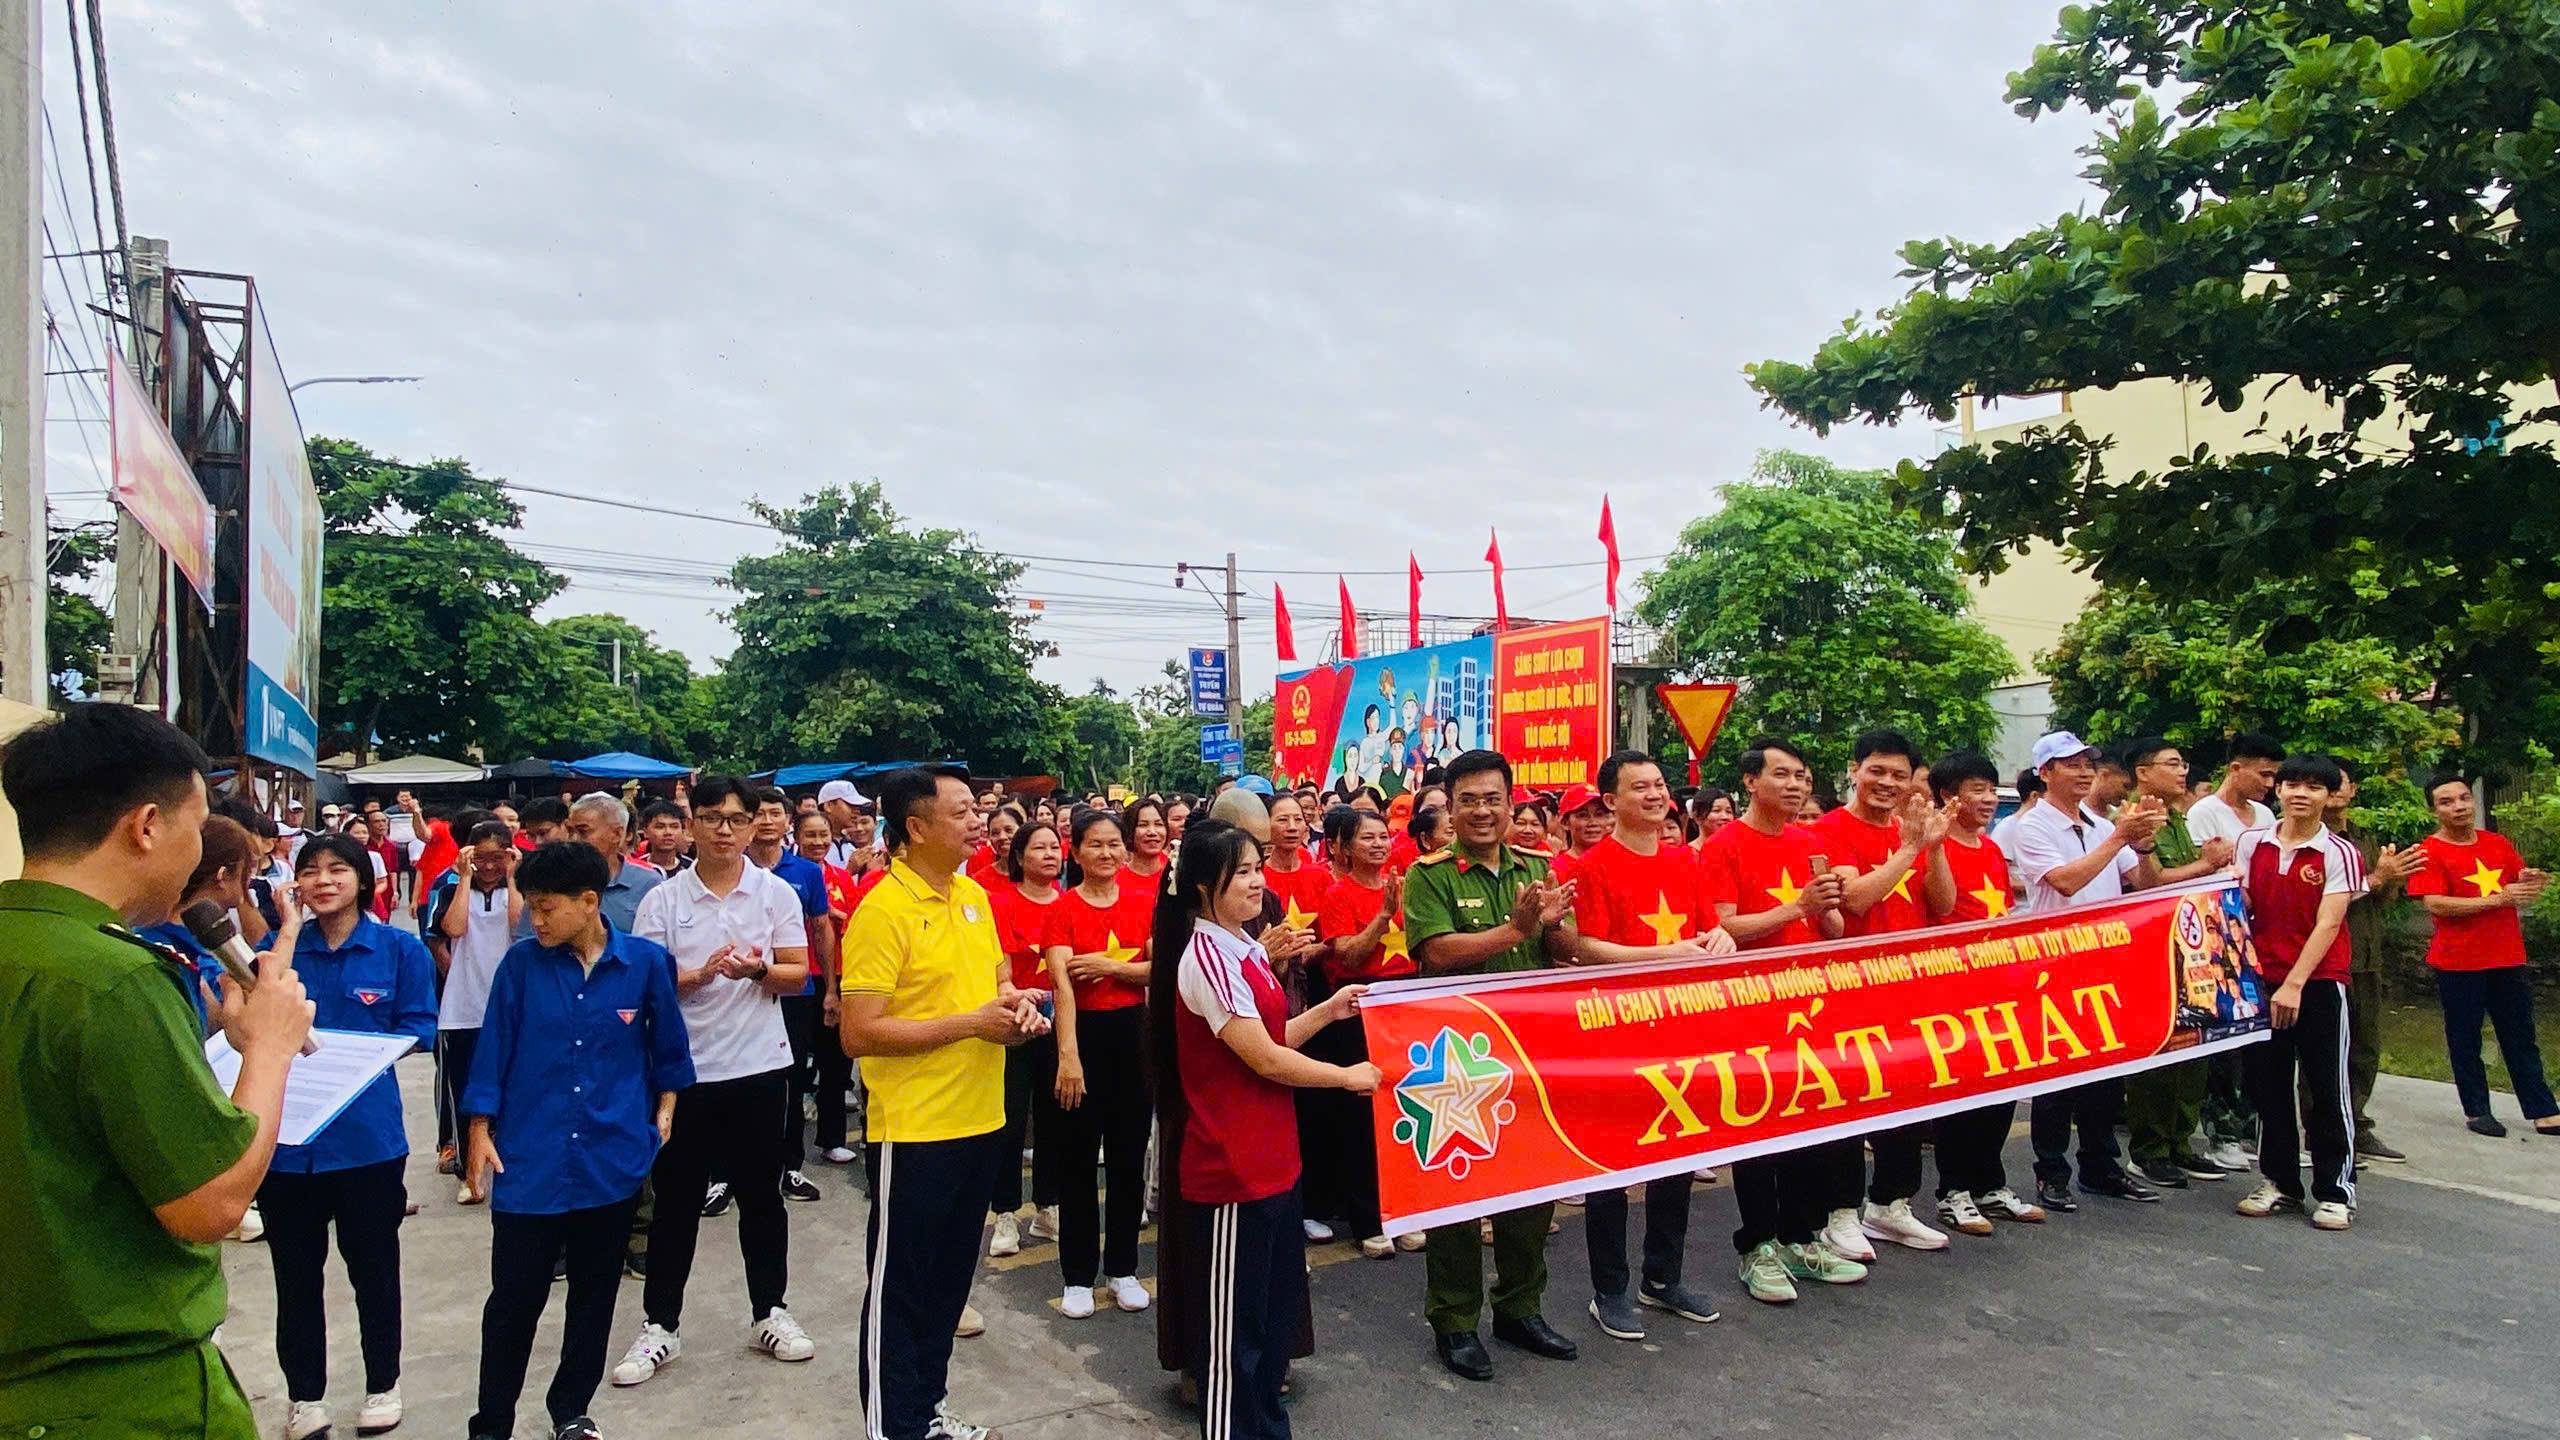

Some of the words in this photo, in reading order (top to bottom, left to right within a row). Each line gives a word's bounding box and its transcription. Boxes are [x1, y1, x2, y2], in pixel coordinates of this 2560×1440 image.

[1575, 987, 1617, 1031] GIẢI
[1616, 988, 1664, 1028] CHẠY
[1665, 980, 1728, 1017] PHONG
[1723, 970, 1771, 1008] TRÀO
[1825, 958, 1863, 992] ỨNG
[1860, 952, 1914, 986] THÁNG
[1965, 931, 2017, 970] CHỐNG
[2013, 934, 2042, 962] MA
[2038, 927, 2068, 958] TÚY
[2064, 922, 2101, 953] NĂM
[2100, 920, 2132, 948] 2026
[1634, 997, 1893, 1146] XUẤT
[1911, 971, 2127, 1089] PHÁT
